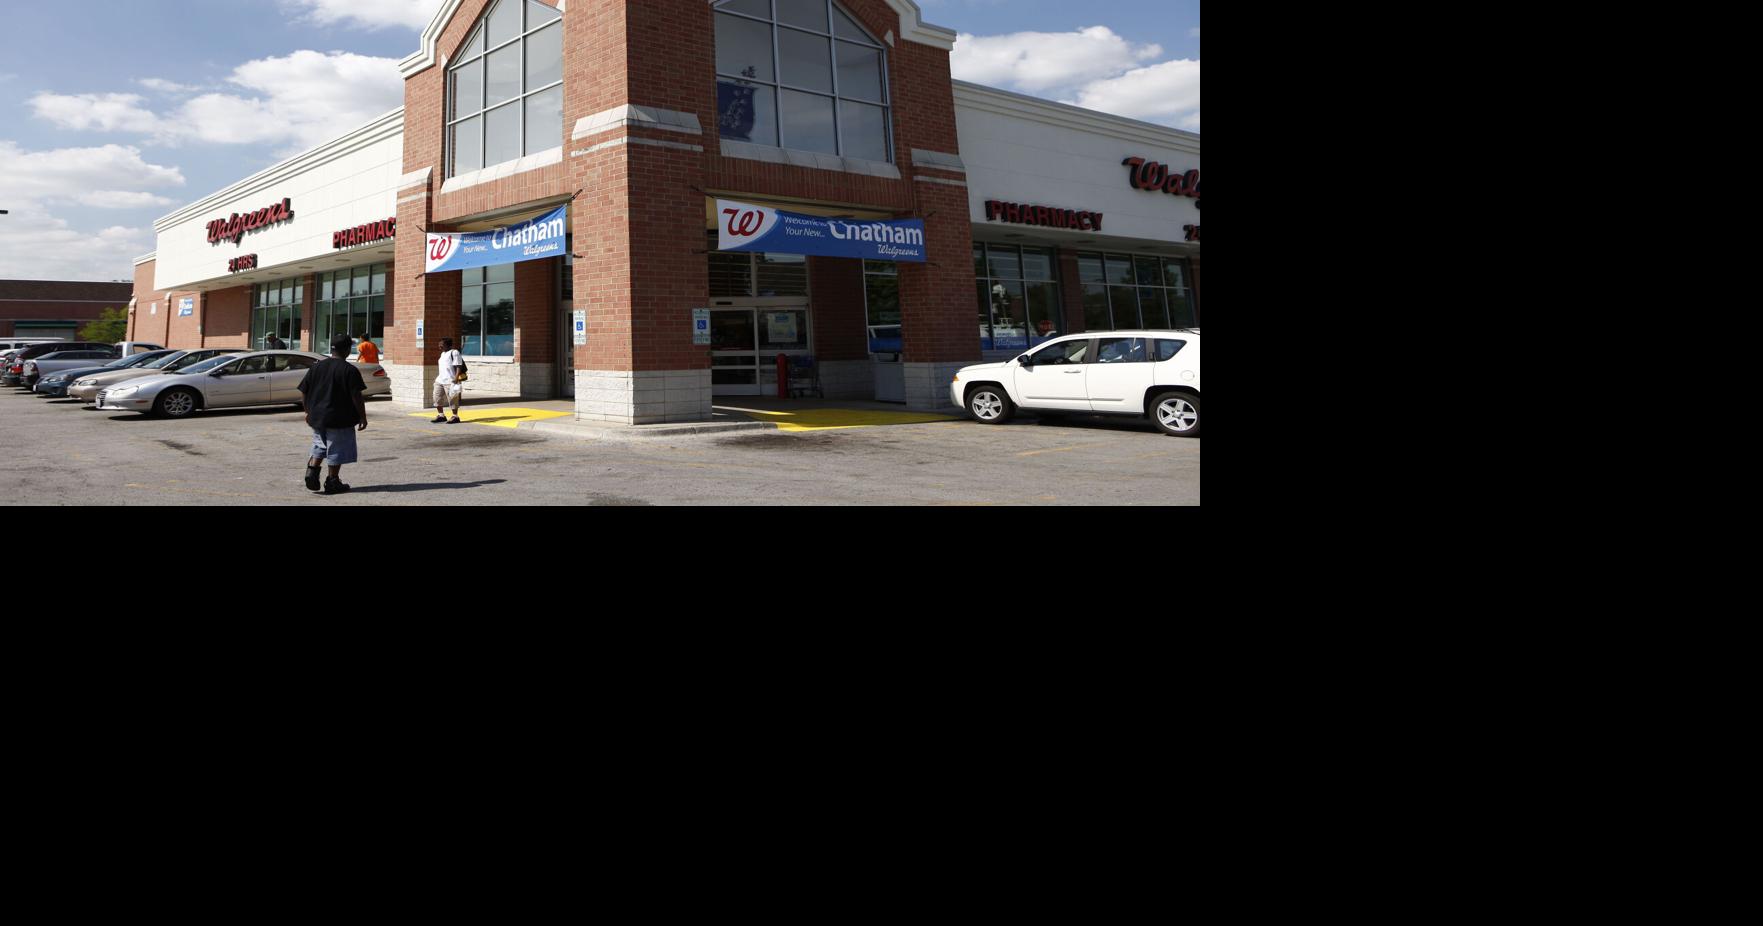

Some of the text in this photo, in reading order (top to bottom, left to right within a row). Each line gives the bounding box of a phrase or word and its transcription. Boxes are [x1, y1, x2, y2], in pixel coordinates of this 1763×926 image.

[1122, 156, 1200, 209] Wal
[206, 197, 294, 247] Walgreens
[985, 200, 1103, 231] PHARMACY
[332, 216, 397, 249] PHARMAC
[491, 217, 564, 250] Chatham
[786, 226, 803, 236] Your
[827, 220, 923, 245] Chatham
[238, 253, 257, 270] HRS
[523, 242, 559, 257] Walgreens
[877, 244, 919, 257] Walgreens
